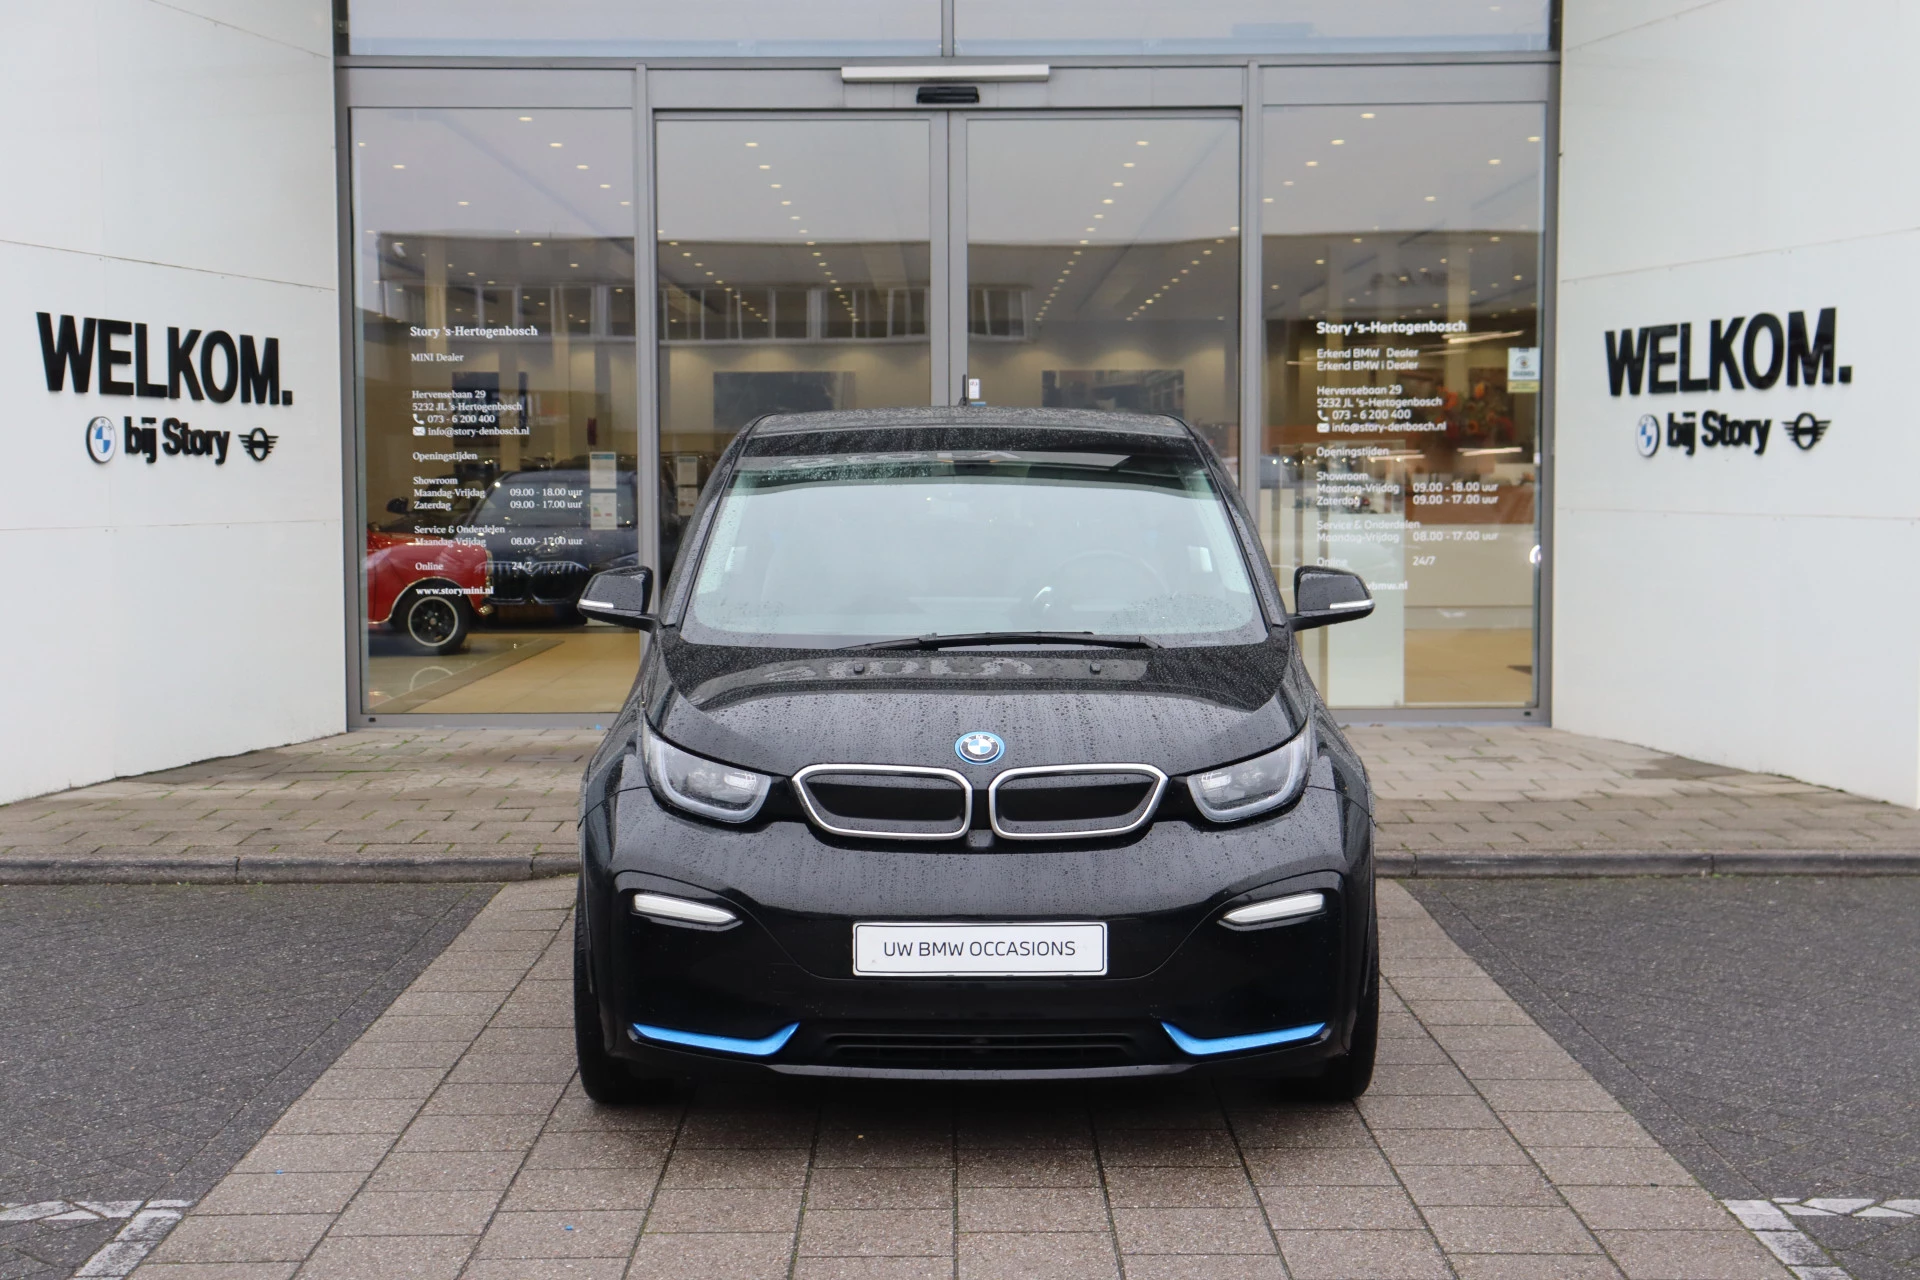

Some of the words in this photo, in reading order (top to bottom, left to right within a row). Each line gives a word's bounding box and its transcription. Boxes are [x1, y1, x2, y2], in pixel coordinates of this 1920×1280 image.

[410, 326, 440, 339] Story
[1316, 322, 1351, 335] Story
[411, 353, 434, 361] MINI
[436, 353, 464, 361] Dealer
[1317, 349, 1350, 358] Erkend
[1353, 349, 1379, 358] BMW
[1387, 348, 1418, 358] Dealer
[1605, 307, 1852, 397] WELKOM.
[36, 312, 293, 406] WELKOM.
[1317, 361, 1350, 371] Erkend
[1353, 361, 1379, 370] BMW
[1387, 360, 1418, 370] Dealer
[412, 390, 473, 398] Hervensebaan
[474, 390, 486, 398] 29
[1317, 386, 1387, 395] Hervensebaan
[1389, 385, 1402, 395] 29
[412, 403, 434, 411] 5232
[436, 403, 447, 412] JL
[1317, 398, 1341, 408] 5232
[1343, 398, 1353, 408] JL
[428, 414, 445, 423] 073
[452, 415, 458, 423] 6
[460, 414, 476, 423] 200
[478, 414, 495, 423] 400
[1332, 410, 1351, 419] 073
[1360, 410, 1366, 419] 6
[1368, 410, 1389, 419] 200
[1391, 409, 1411, 418] 400
[428, 426, 530, 437] info@story-denbosch.nl
[1332, 422, 1446, 434] info@story-denbosch.nl
[1701, 410, 1772, 455] Story
[162, 417, 230, 465] Story
[413, 452, 477, 462] Openingstijden
[1316, 447, 1389, 458] Openingstijden
[413, 477, 458, 485] Showroom
[1316, 472, 1369, 481] Showroom
[1317, 484, 1400, 495] Maandag-Vrijdag
[1413, 483, 1442, 492] 09.00
[1452, 482, 1479, 492] 18.00
[1482, 484, 1498, 492] uur
[414, 489, 486, 499] Maandag-Vrijdag
[510, 488, 535, 497] 09.00
[542, 488, 566, 496] 18.00
[568, 489, 583, 497] uur
[1317, 496, 1361, 507] Zaterdag
[1413, 495, 1442, 504] 09.00
[1452, 495, 1479, 504] 17.00
[1482, 496, 1498, 504] uur
[414, 501, 451, 511] Zaterdag
[510, 501, 535, 509] 09.00
[542, 501, 565, 509] 17.00
[414, 525, 446, 534] Service
[448, 525, 454, 534] &
[456, 525, 505, 534] Onderdelen
[1316, 521, 1352, 530] Service
[1354, 521, 1361, 529] &
[1364, 520, 1420, 529] Onderdelen
[1317, 533, 1399, 543] Maandag-Vrijdag
[1413, 532, 1442, 541] 08.00
[1452, 531, 1479, 541] 17.00
[1482, 533, 1498, 541] uur
[415, 538, 486, 548] Maandag-Vrijdag
[511, 537, 536, 546] 08.00
[543, 537, 566, 546] 17.00
[568, 538, 583, 546] uur
[512, 561, 532, 570] 24/7
[1317, 557, 1348, 567] Online
[1413, 556, 1435, 566] 24/7
[416, 562, 444, 571] Online
[416, 586, 494, 596] www.storymini.nl
[884, 942, 913, 957] UW
[919, 941, 964, 956] BMW
[970, 941, 1076, 956] OCCASIONS
